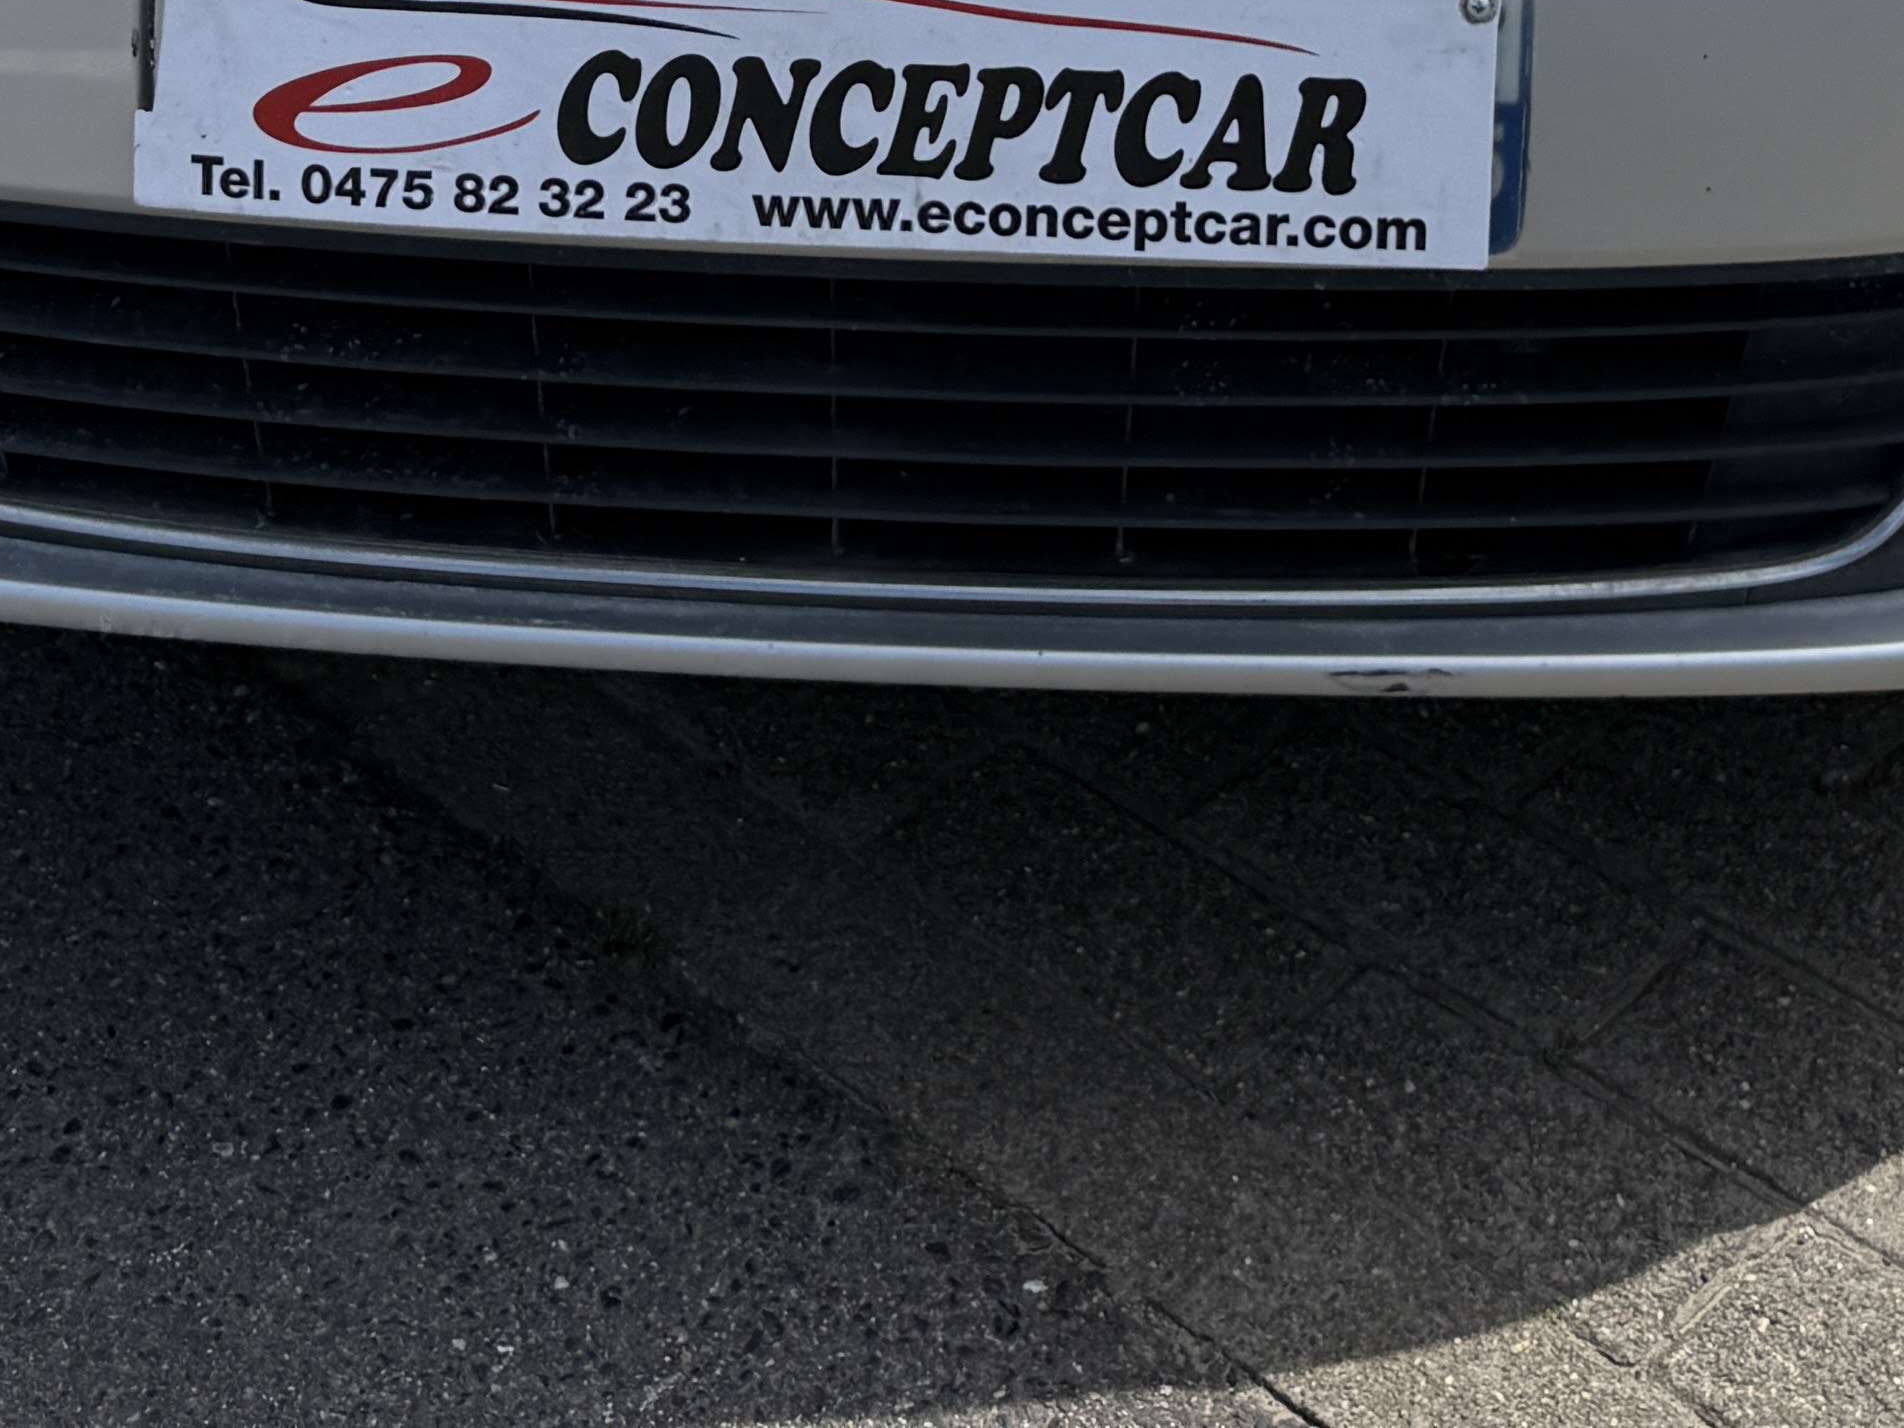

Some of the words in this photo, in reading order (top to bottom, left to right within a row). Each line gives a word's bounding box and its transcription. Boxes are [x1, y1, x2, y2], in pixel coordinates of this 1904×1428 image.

[556, 48, 1368, 197] CONCEPTCAR
[190, 153, 281, 201] Tel.
[300, 162, 436, 212] 0475
[453, 172, 520, 216] 82
[538, 177, 606, 220] 32
[624, 181, 692, 225] 23
[751, 192, 1428, 253] www.econceptcar.com
